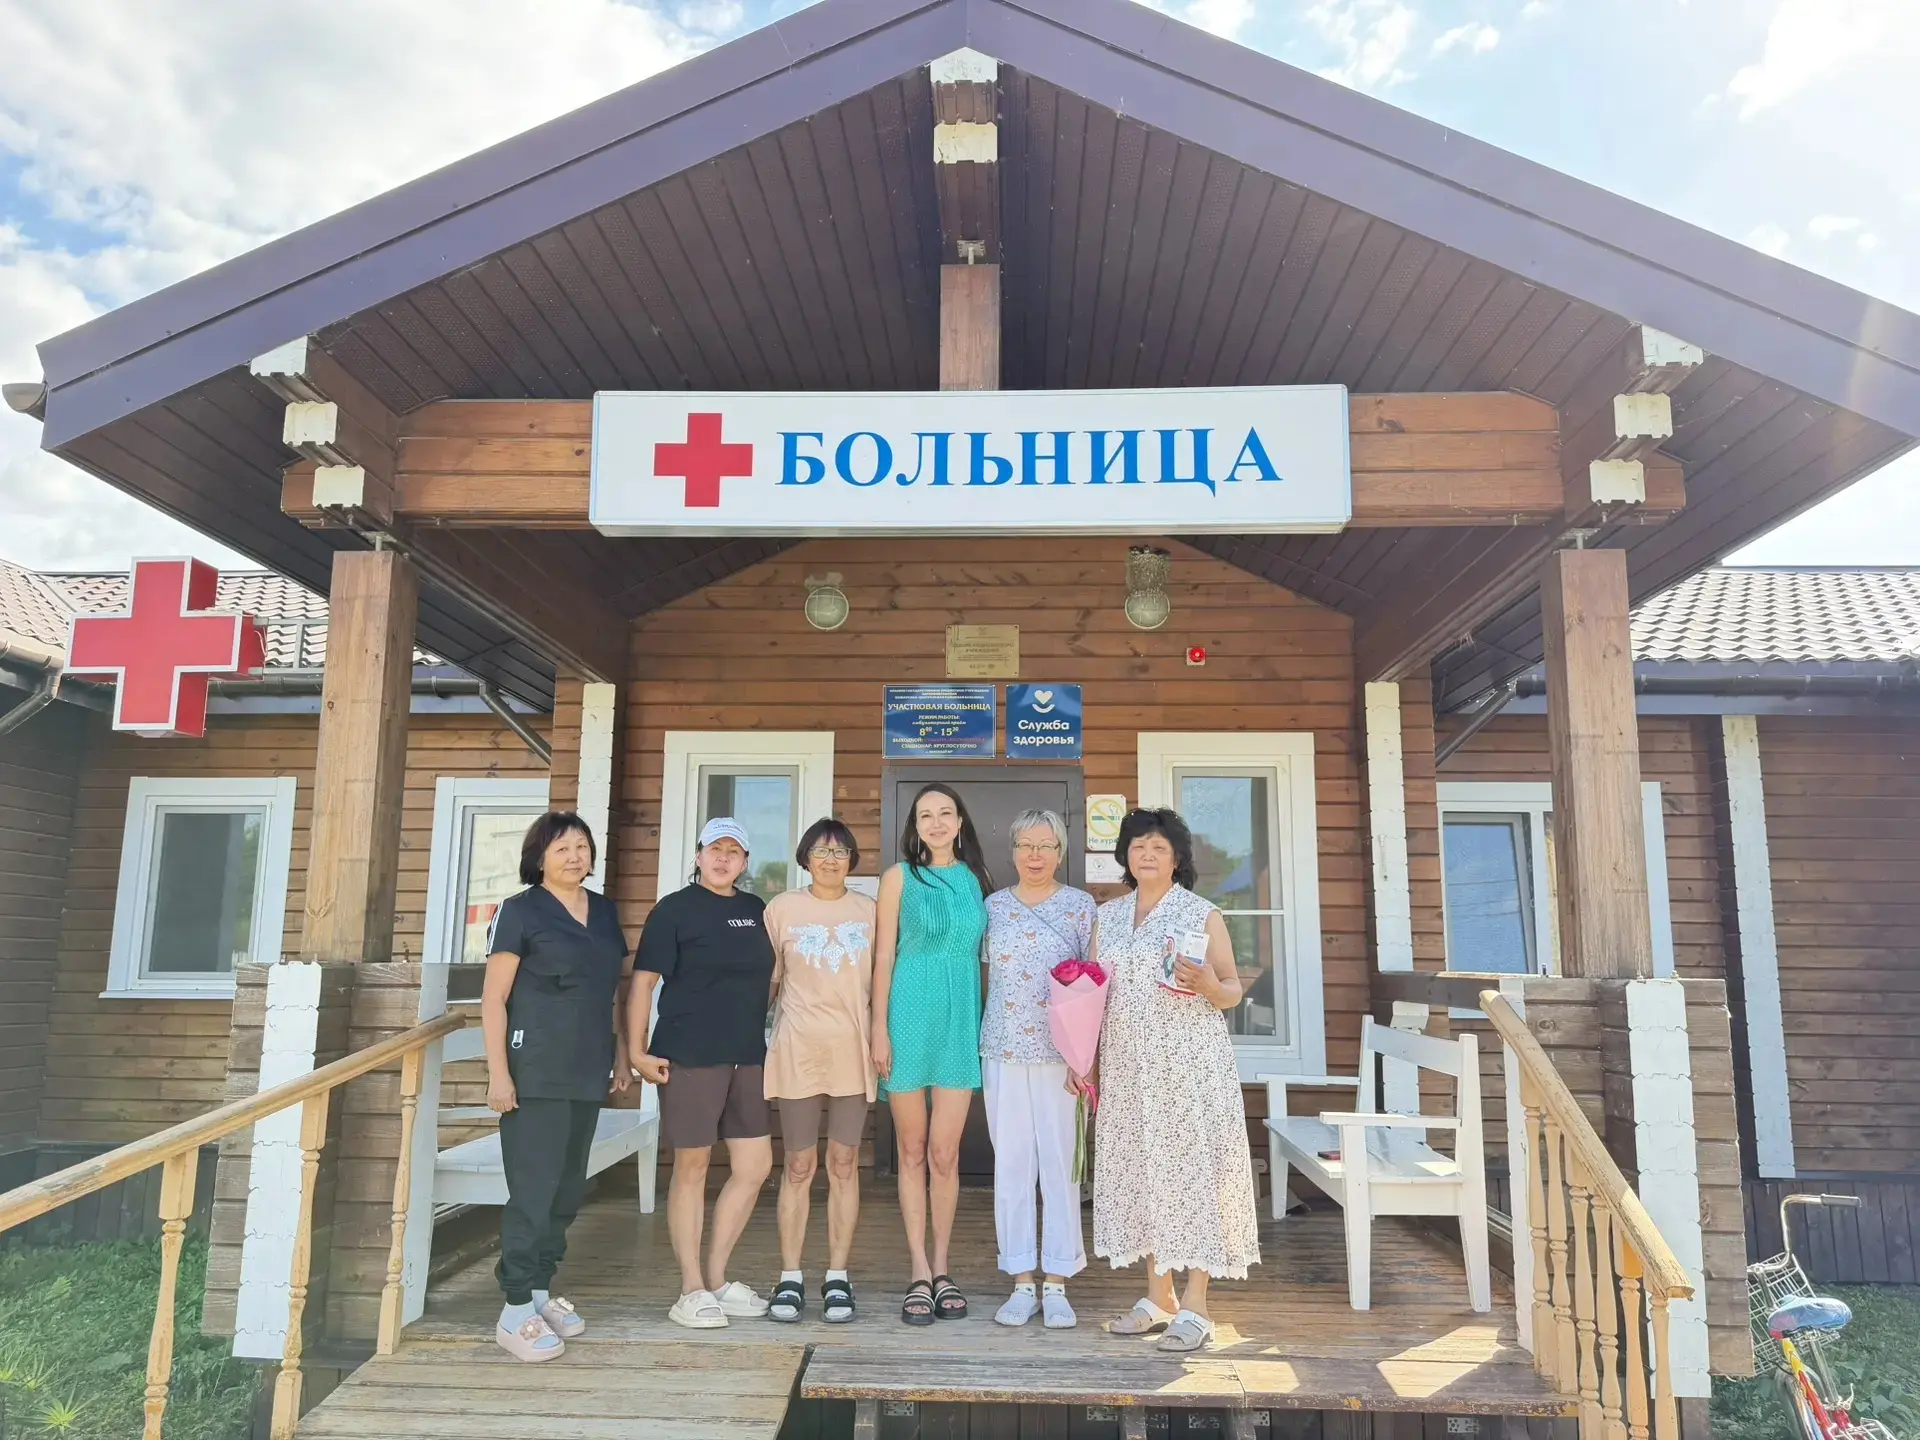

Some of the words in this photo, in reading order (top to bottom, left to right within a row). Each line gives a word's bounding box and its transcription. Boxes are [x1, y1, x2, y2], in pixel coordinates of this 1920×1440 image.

[775, 426, 1283, 497] БОЛЬНИЦА
[888, 703, 942, 711] УЧАСТКОВАЯ
[944, 703, 991, 711] БОЛЬНИЦА
[1018, 719, 1070, 732] Служба
[1013, 736, 1075, 747] здоровья
